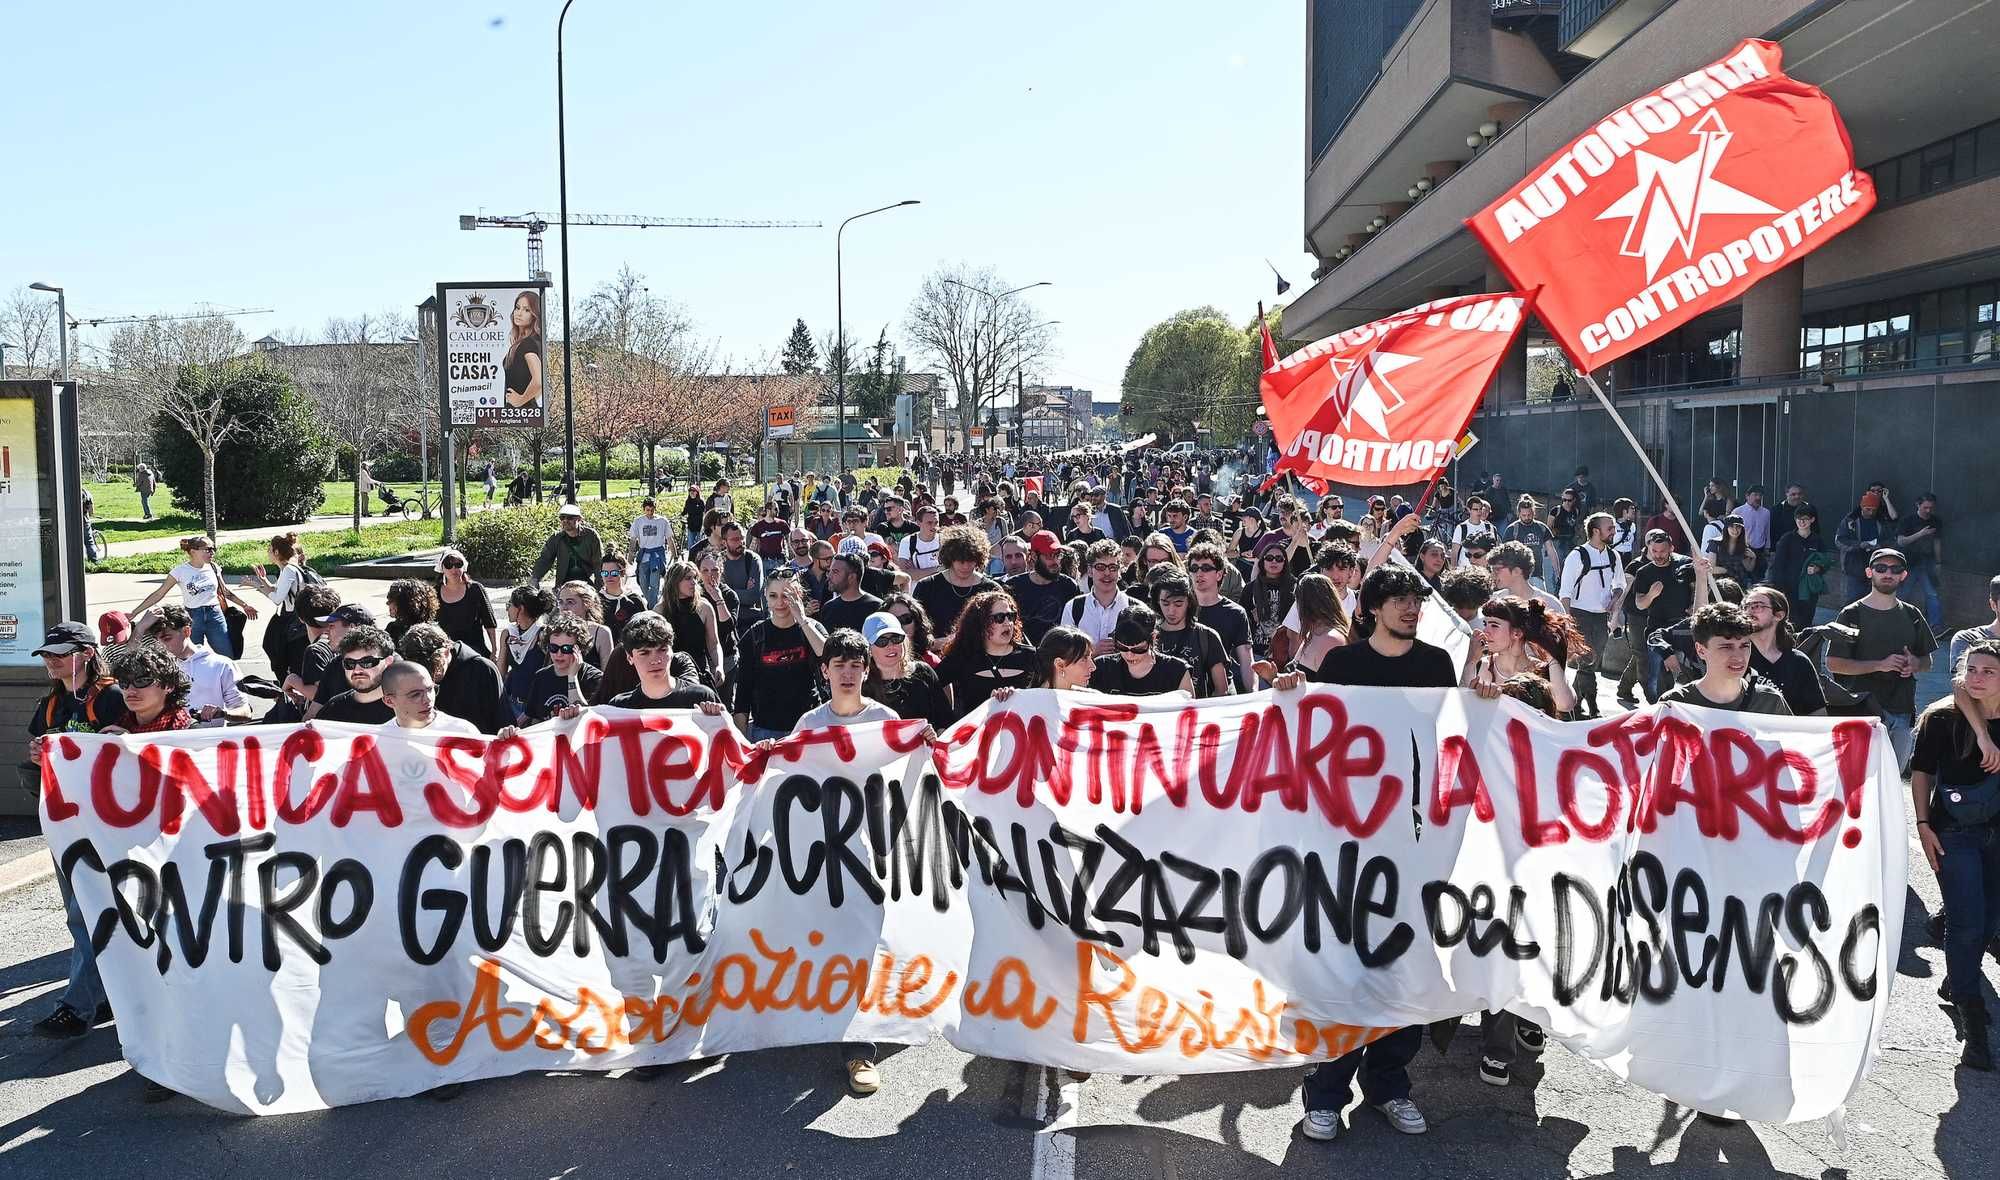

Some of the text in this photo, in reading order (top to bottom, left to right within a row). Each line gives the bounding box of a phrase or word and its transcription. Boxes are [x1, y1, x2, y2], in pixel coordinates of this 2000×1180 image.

[1494, 44, 1771, 244] AUTONOMIA
[1579, 170, 1863, 354] CONTROPOTERE
[449, 331, 505, 341] CARLORE
[450, 352, 491, 363] CERCHI
[450, 365, 498, 380] CASA?
[451, 383, 492, 394] Chiamaci!
[478, 408, 541, 418] 011 533628
[770, 411, 793, 422] TAXI
[1429, 735, 1494, 826] A
[61, 832, 375, 975] CONTRO
[406, 928, 958, 1066] Associazione
[964, 956, 1058, 1030] a
